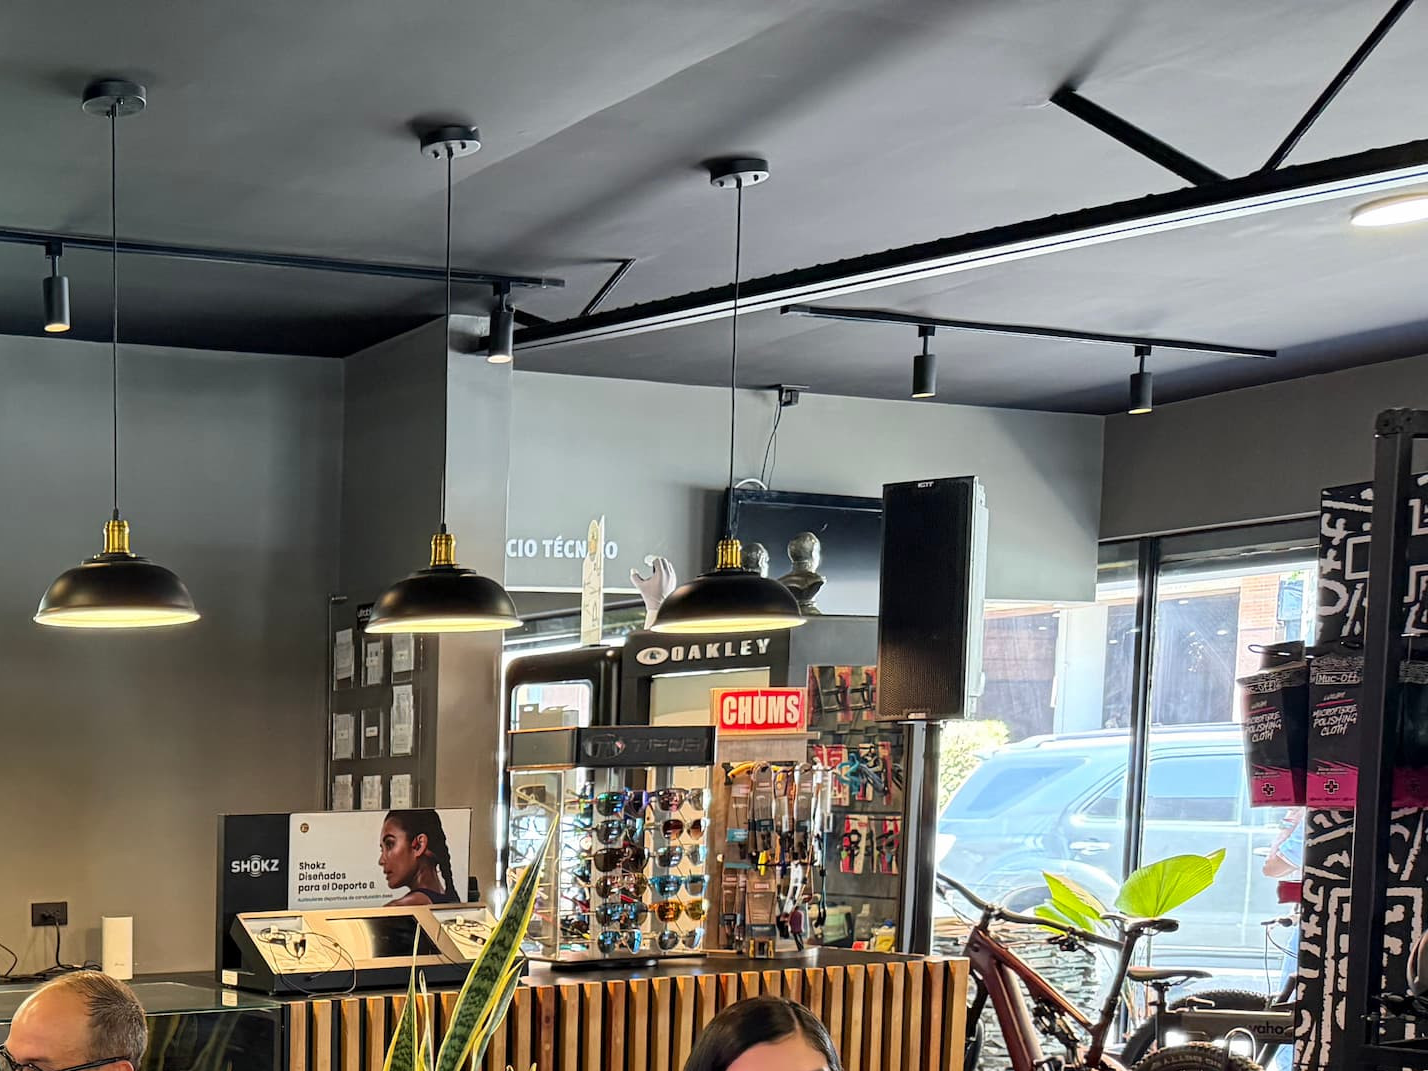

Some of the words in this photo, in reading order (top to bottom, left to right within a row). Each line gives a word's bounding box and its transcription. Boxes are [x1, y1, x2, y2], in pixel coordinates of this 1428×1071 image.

[542, 535, 618, 559] TÉCNO
[671, 638, 770, 662] OAKLEY
[722, 694, 800, 725] CHUMS
[1321, 724, 1348, 737] CLOTH
[231, 855, 279, 877] SHOKZ
[299, 861, 326, 870] Shokz
[298, 871, 346, 882] Diseñados
[298, 884, 320, 894] para
[322, 882, 329, 891] el
[331, 880, 368, 893] Deporte
